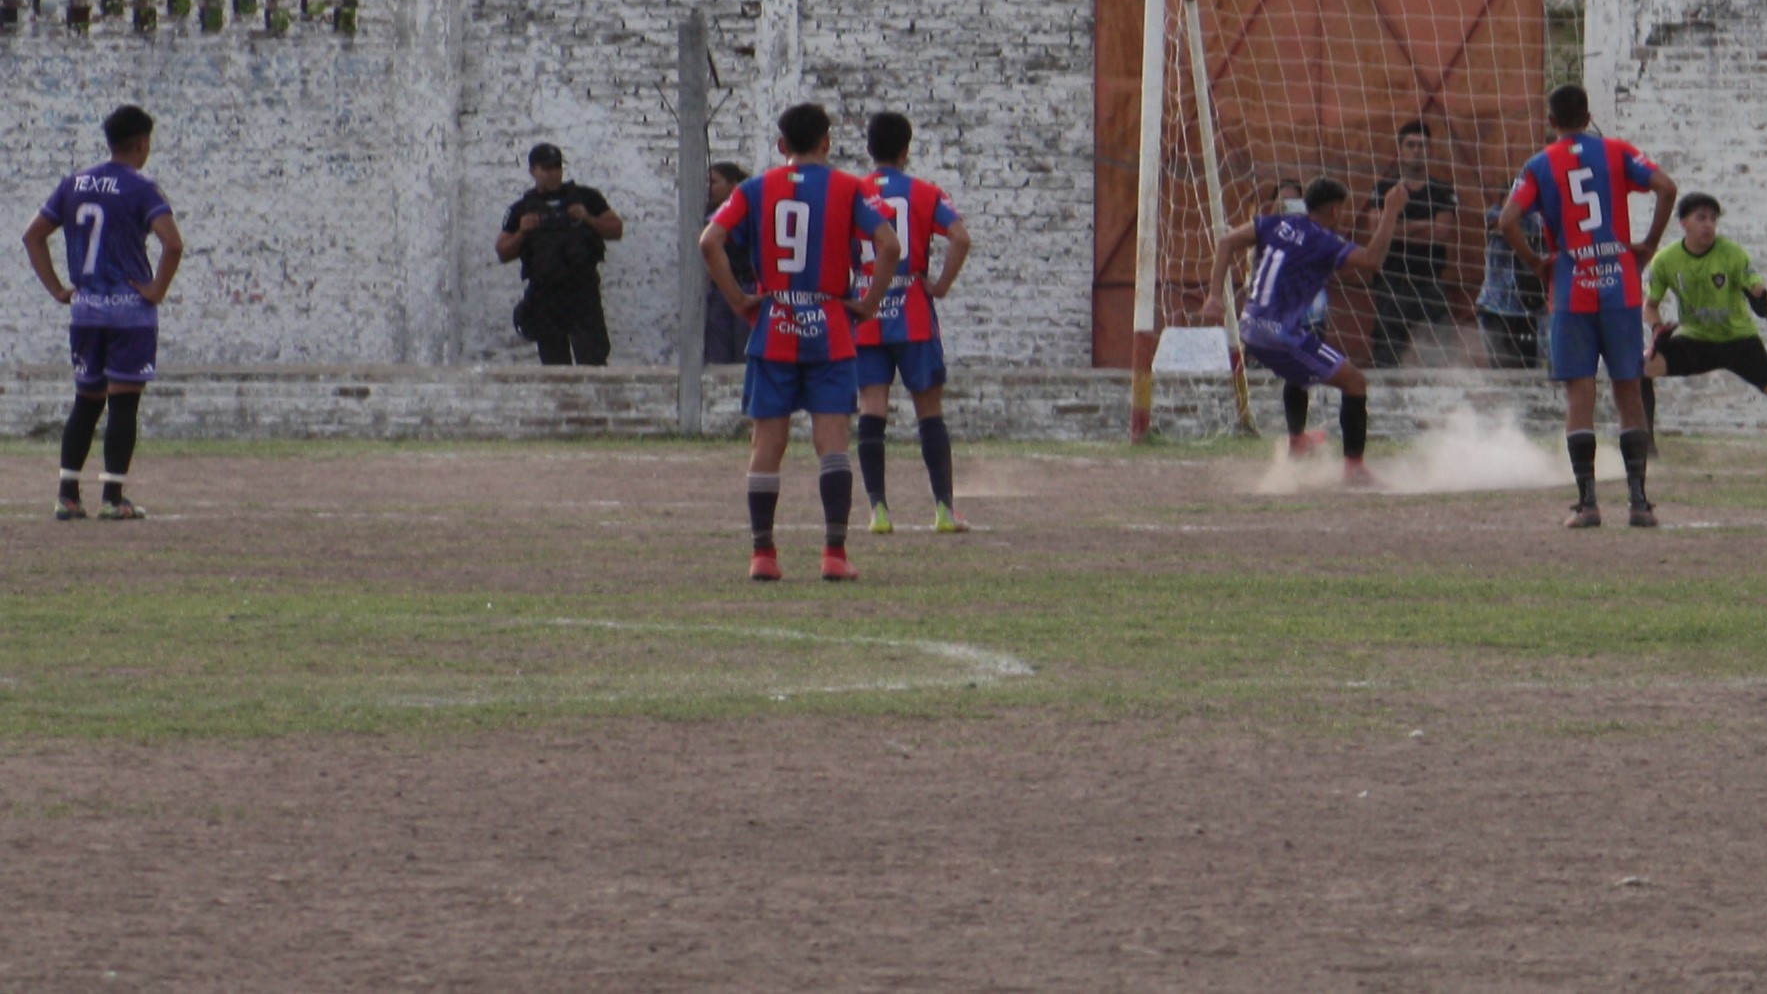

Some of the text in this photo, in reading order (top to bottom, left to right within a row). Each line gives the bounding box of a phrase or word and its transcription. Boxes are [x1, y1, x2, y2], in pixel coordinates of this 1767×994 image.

[75, 175, 120, 195] TEXTIL
[1567, 167, 1602, 232] 5
[75, 202, 105, 275] 7
[775, 199, 810, 273] 9
[1251, 245, 1286, 307] 11
